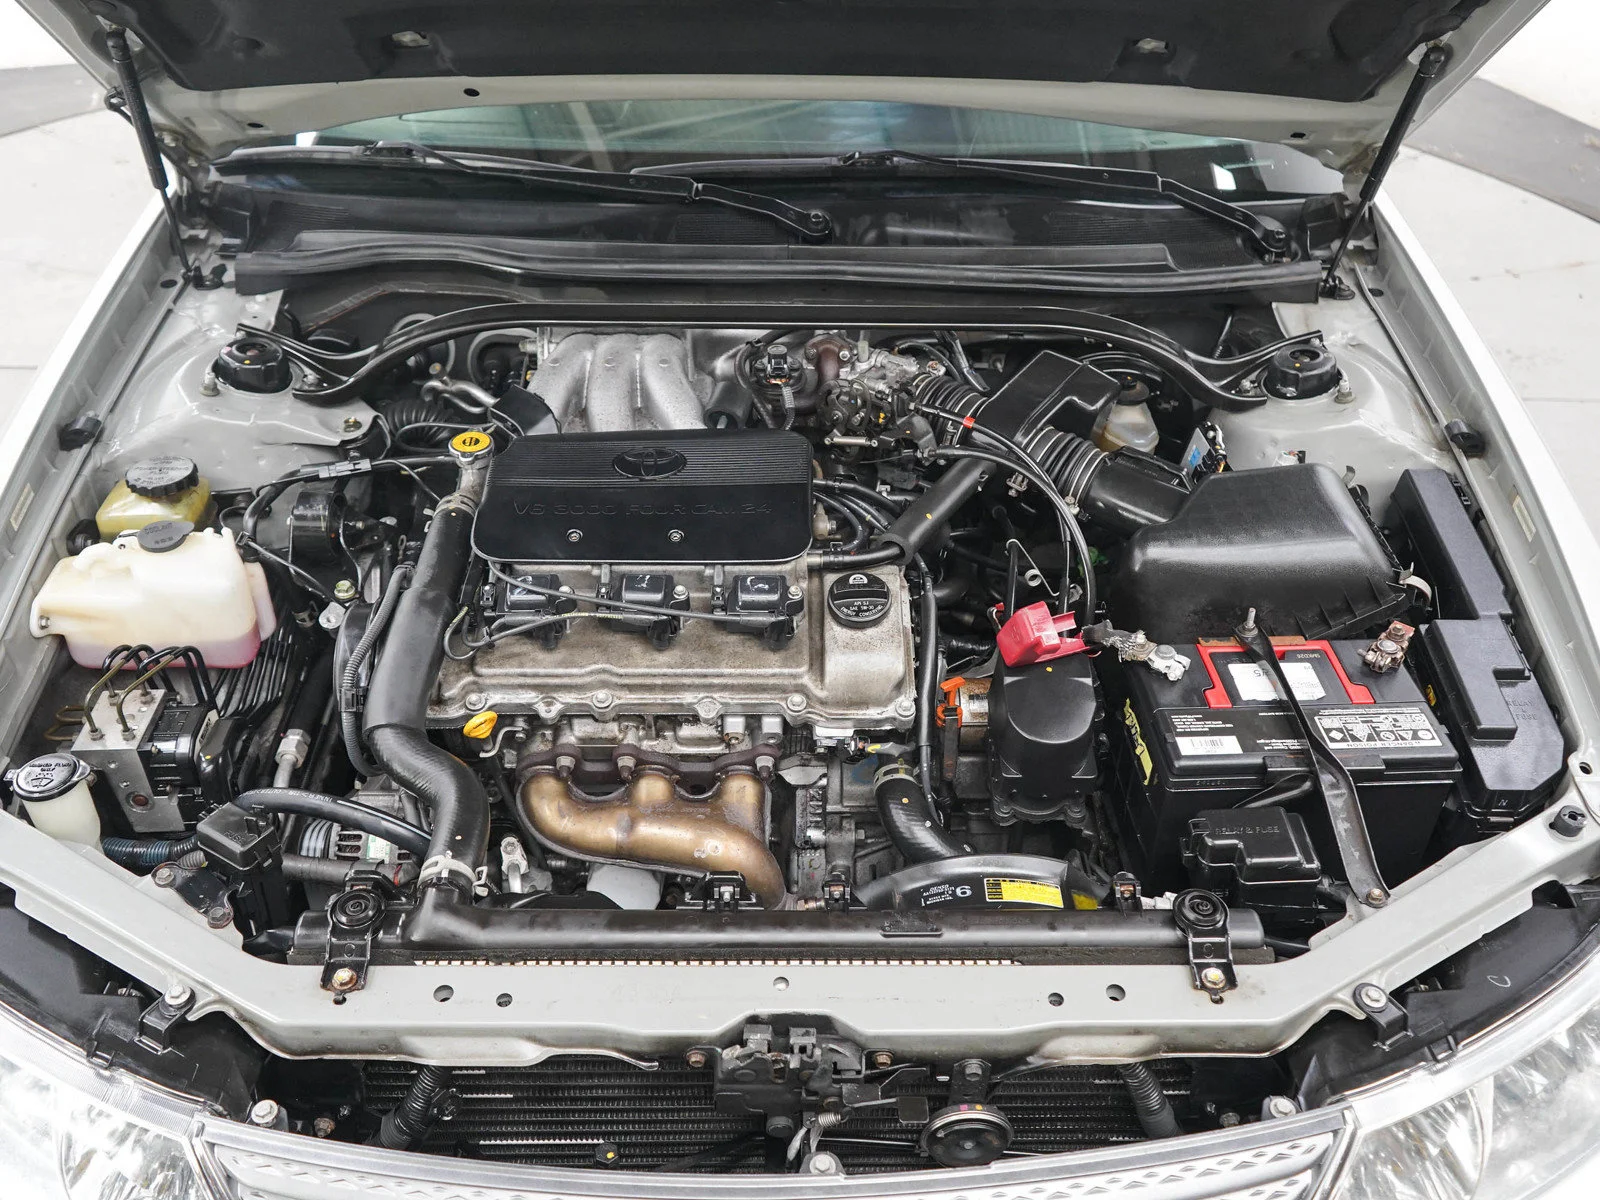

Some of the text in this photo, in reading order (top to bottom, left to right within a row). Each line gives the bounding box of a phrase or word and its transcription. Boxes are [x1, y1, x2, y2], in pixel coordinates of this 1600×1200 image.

[514, 500, 545, 516] V6
[625, 503, 687, 516] FOUR
[741, 502, 772, 515] 24
[955, 885, 972, 898] 6
